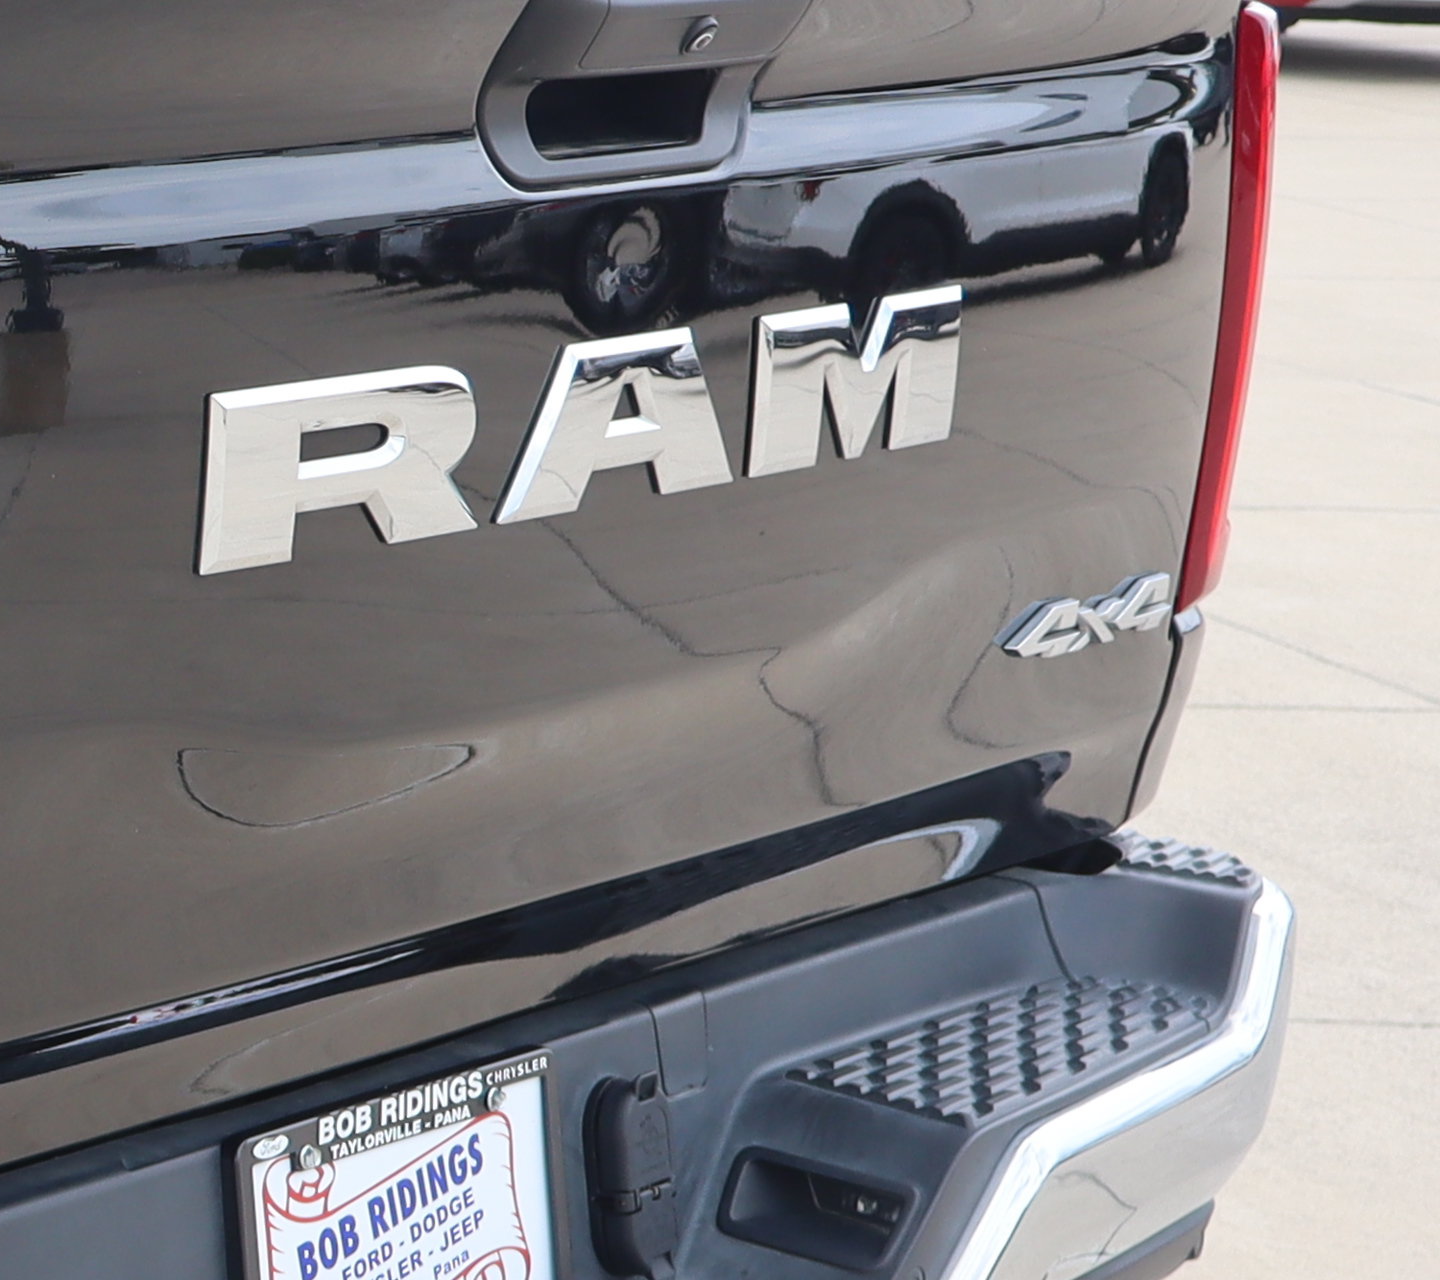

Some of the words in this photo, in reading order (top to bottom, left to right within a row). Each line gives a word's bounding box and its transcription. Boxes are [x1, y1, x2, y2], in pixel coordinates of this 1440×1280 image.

[195, 283, 964, 577] RAM
[318, 1107, 372, 1145] BOB
[380, 1070, 483, 1126] RIDINGS
[486, 1056, 548, 1087] CHRYSLER
[330, 1119, 421, 1161] TAYLORVILLE
[435, 1104, 471, 1129] PANA
[367, 1133, 484, 1244] RIDINGS
[410, 1187, 476, 1244] DODGE
[439, 1209, 484, 1254] JEEP
[433, 1249, 470, 1280] Pana
